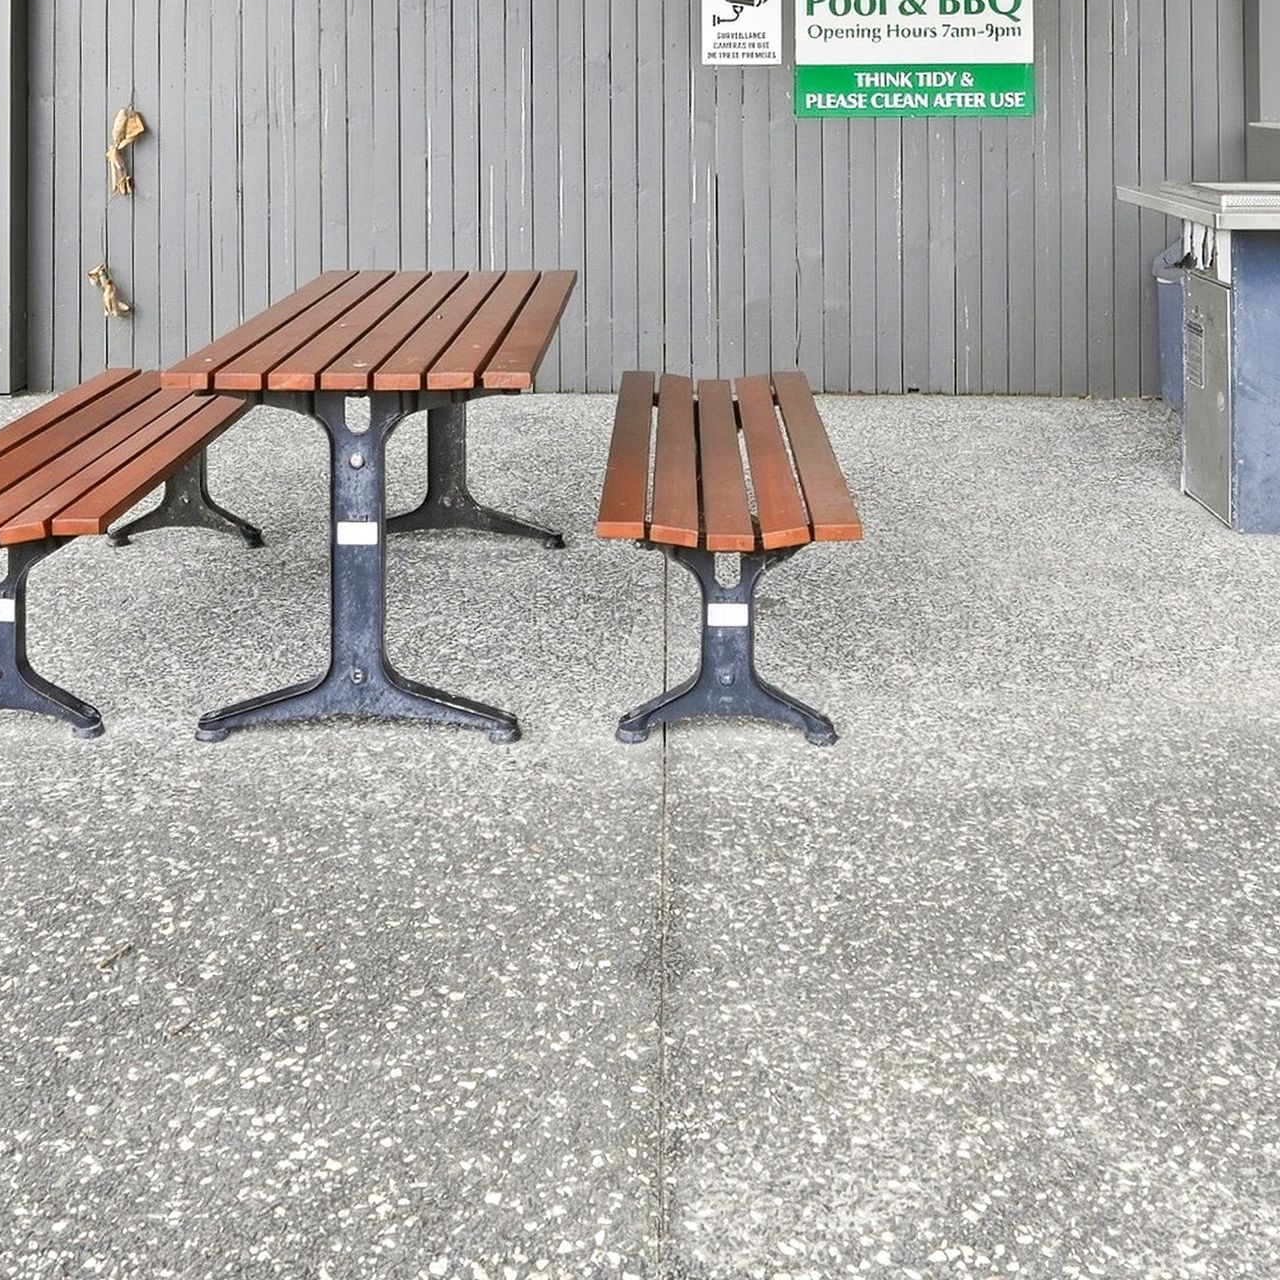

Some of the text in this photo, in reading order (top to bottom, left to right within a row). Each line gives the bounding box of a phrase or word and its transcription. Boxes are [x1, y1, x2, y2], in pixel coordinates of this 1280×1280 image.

[807, 23, 1022, 43] Opening Hours 7am-9pm
[855, 72, 974, 88] THINK TIDY &
[805, 91, 1026, 109] PLEASE CLEAN AFTER USE
